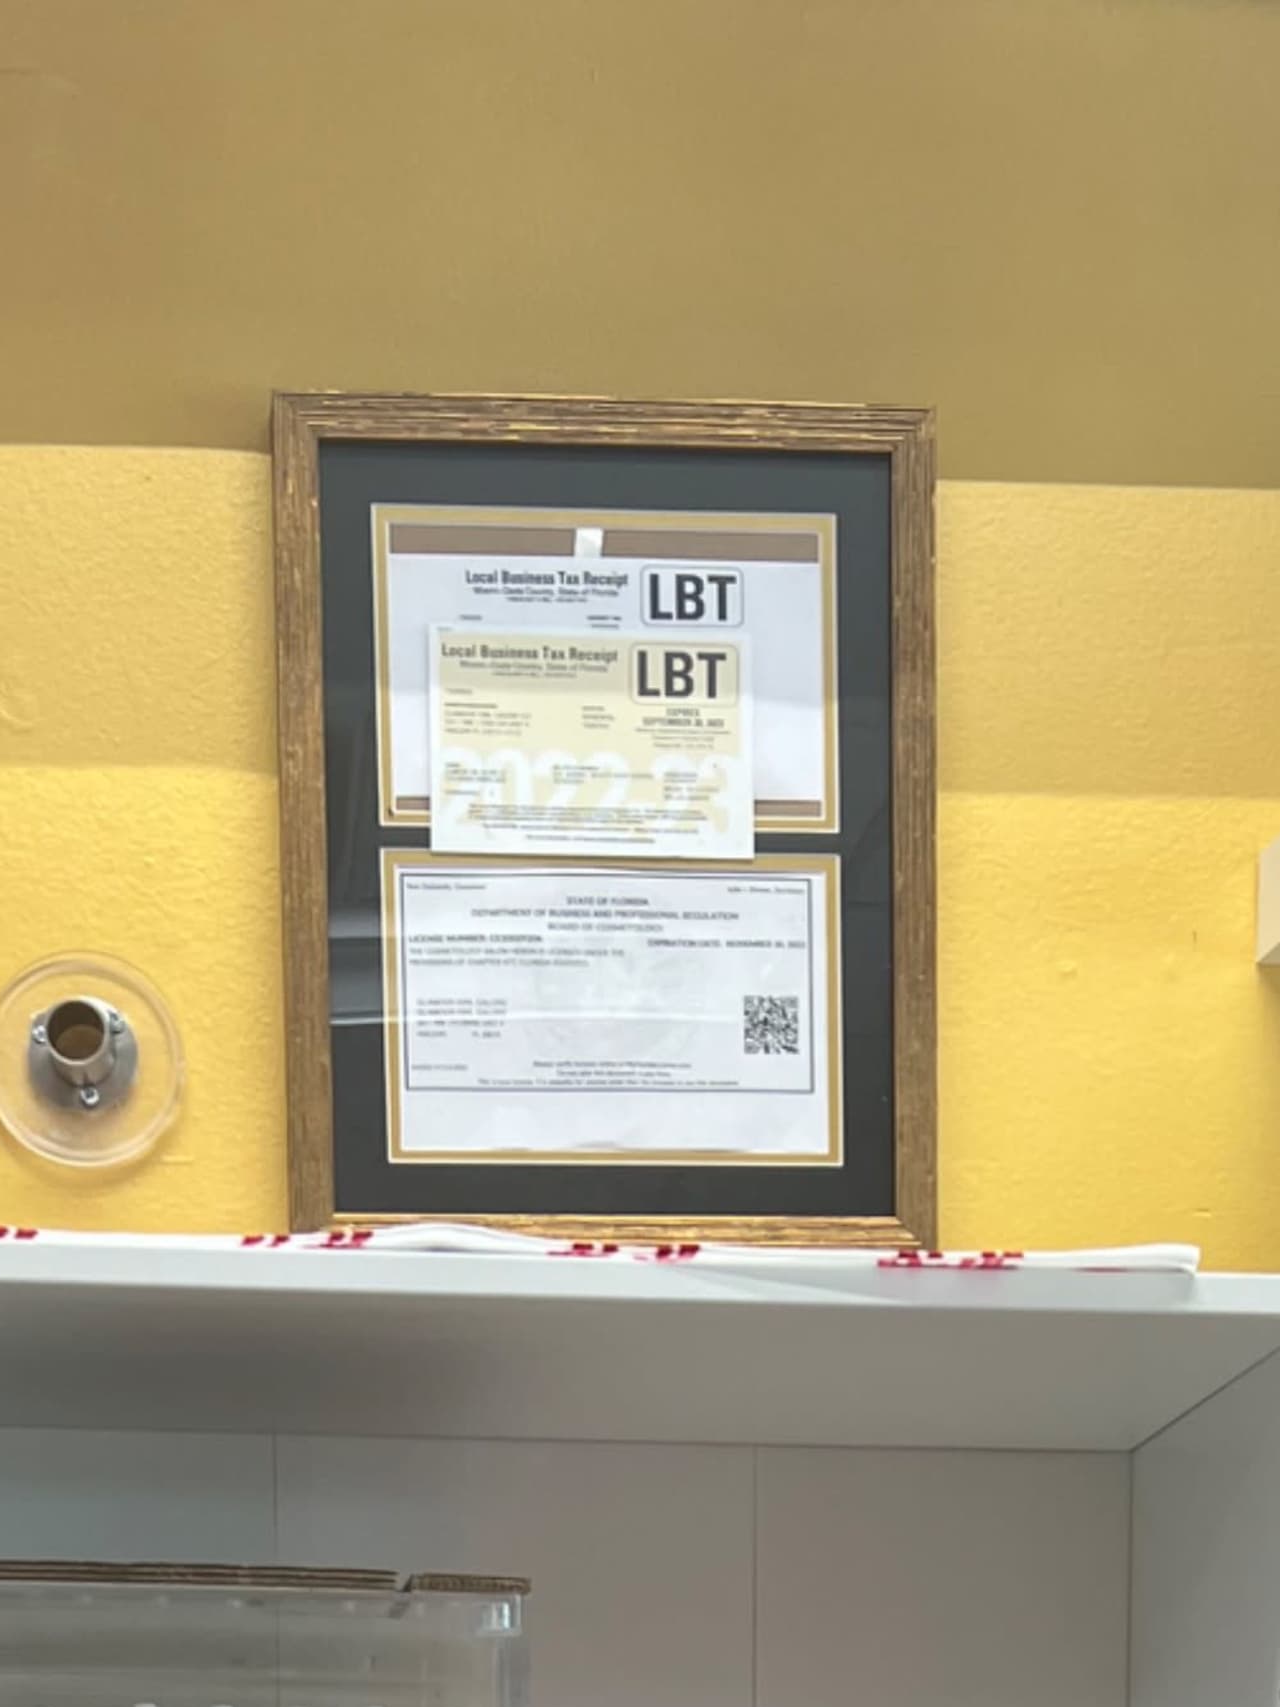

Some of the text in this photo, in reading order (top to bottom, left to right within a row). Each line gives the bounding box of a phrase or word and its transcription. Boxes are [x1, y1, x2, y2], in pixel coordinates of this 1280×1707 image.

[465, 569, 628, 589] Local Business Tax Receipt
[649, 573, 737, 622] LBT
[441, 643, 618, 663] Local Business Tax Receipt
[637, 650, 727, 699] LBT
